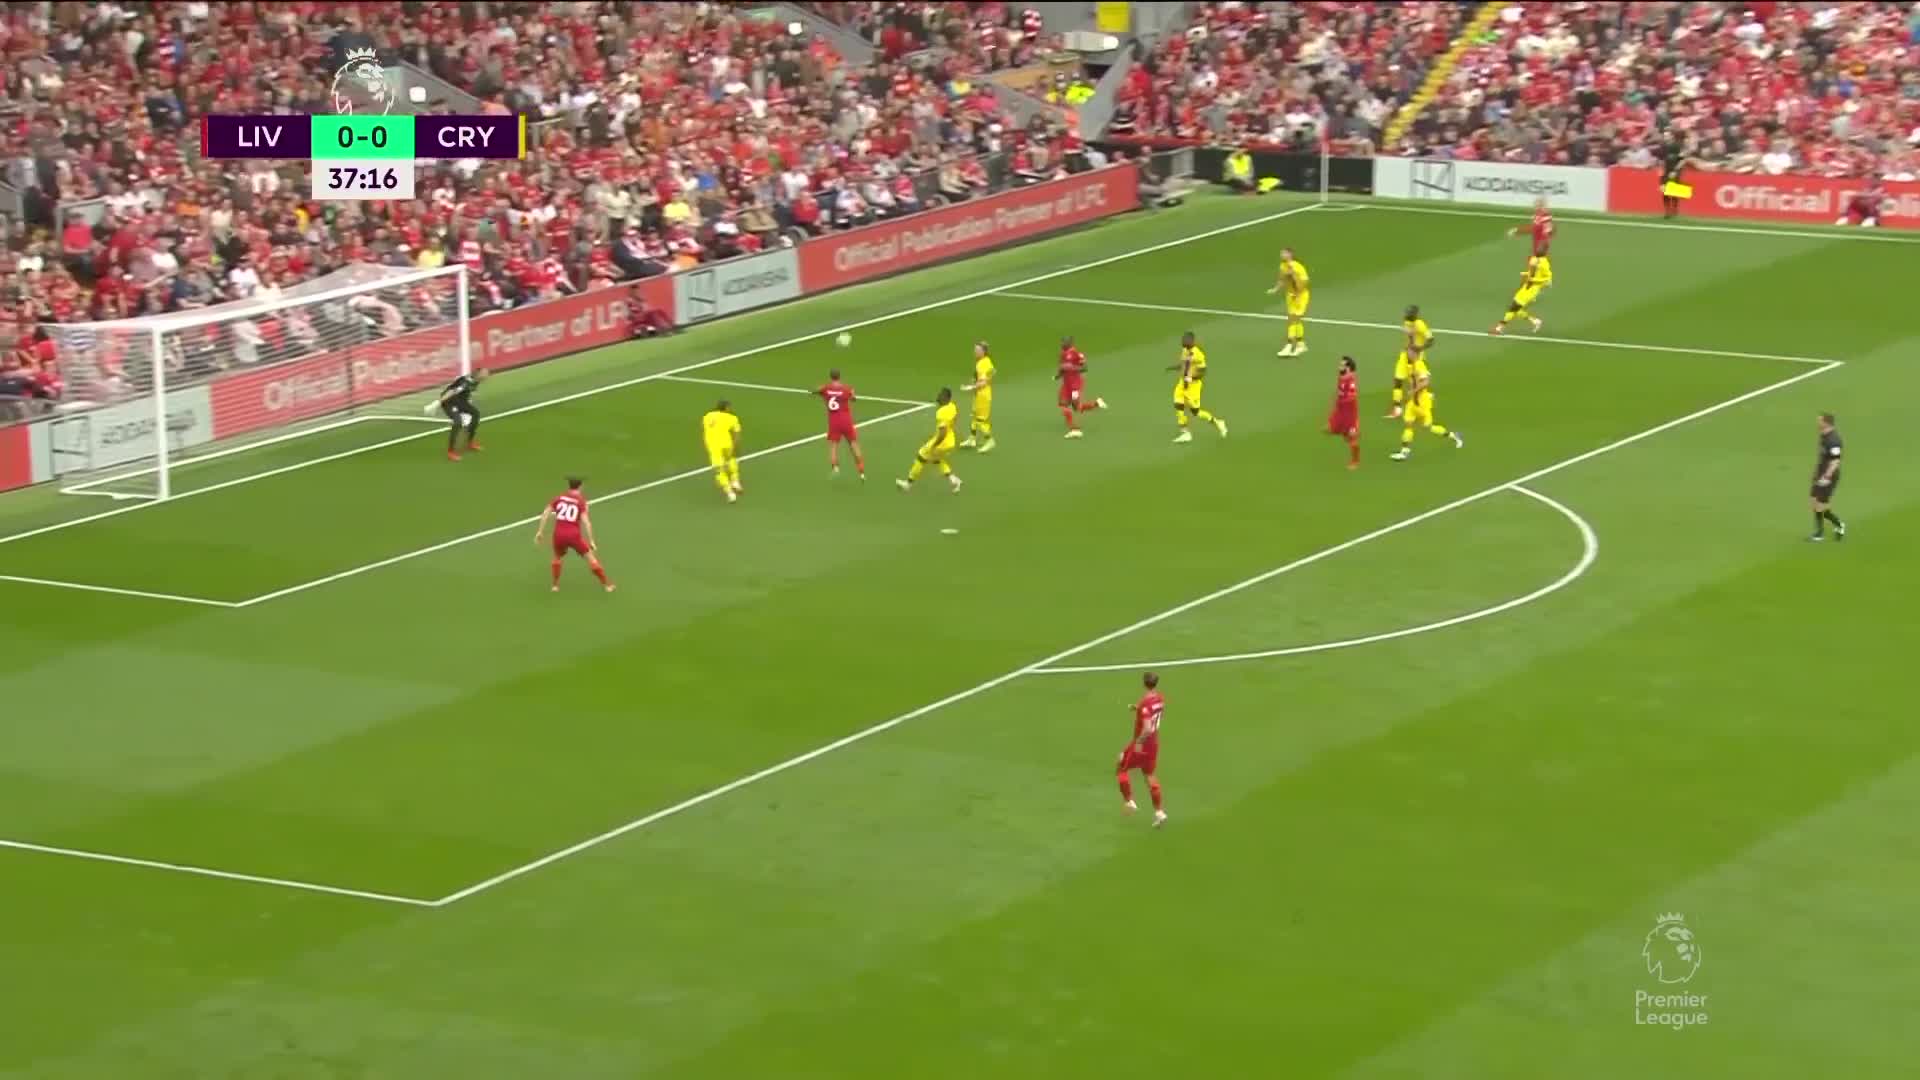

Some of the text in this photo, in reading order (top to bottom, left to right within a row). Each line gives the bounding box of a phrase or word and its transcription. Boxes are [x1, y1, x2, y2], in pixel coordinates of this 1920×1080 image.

[1715, 184, 1832, 213] Official
[835, 182, 1107, 272] Official Publication Partner of LFC
[487, 321, 566, 357] Partner
[569, 308, 593, 337] of
[828, 396, 841, 411] 6
[555, 500, 580, 522] 20
